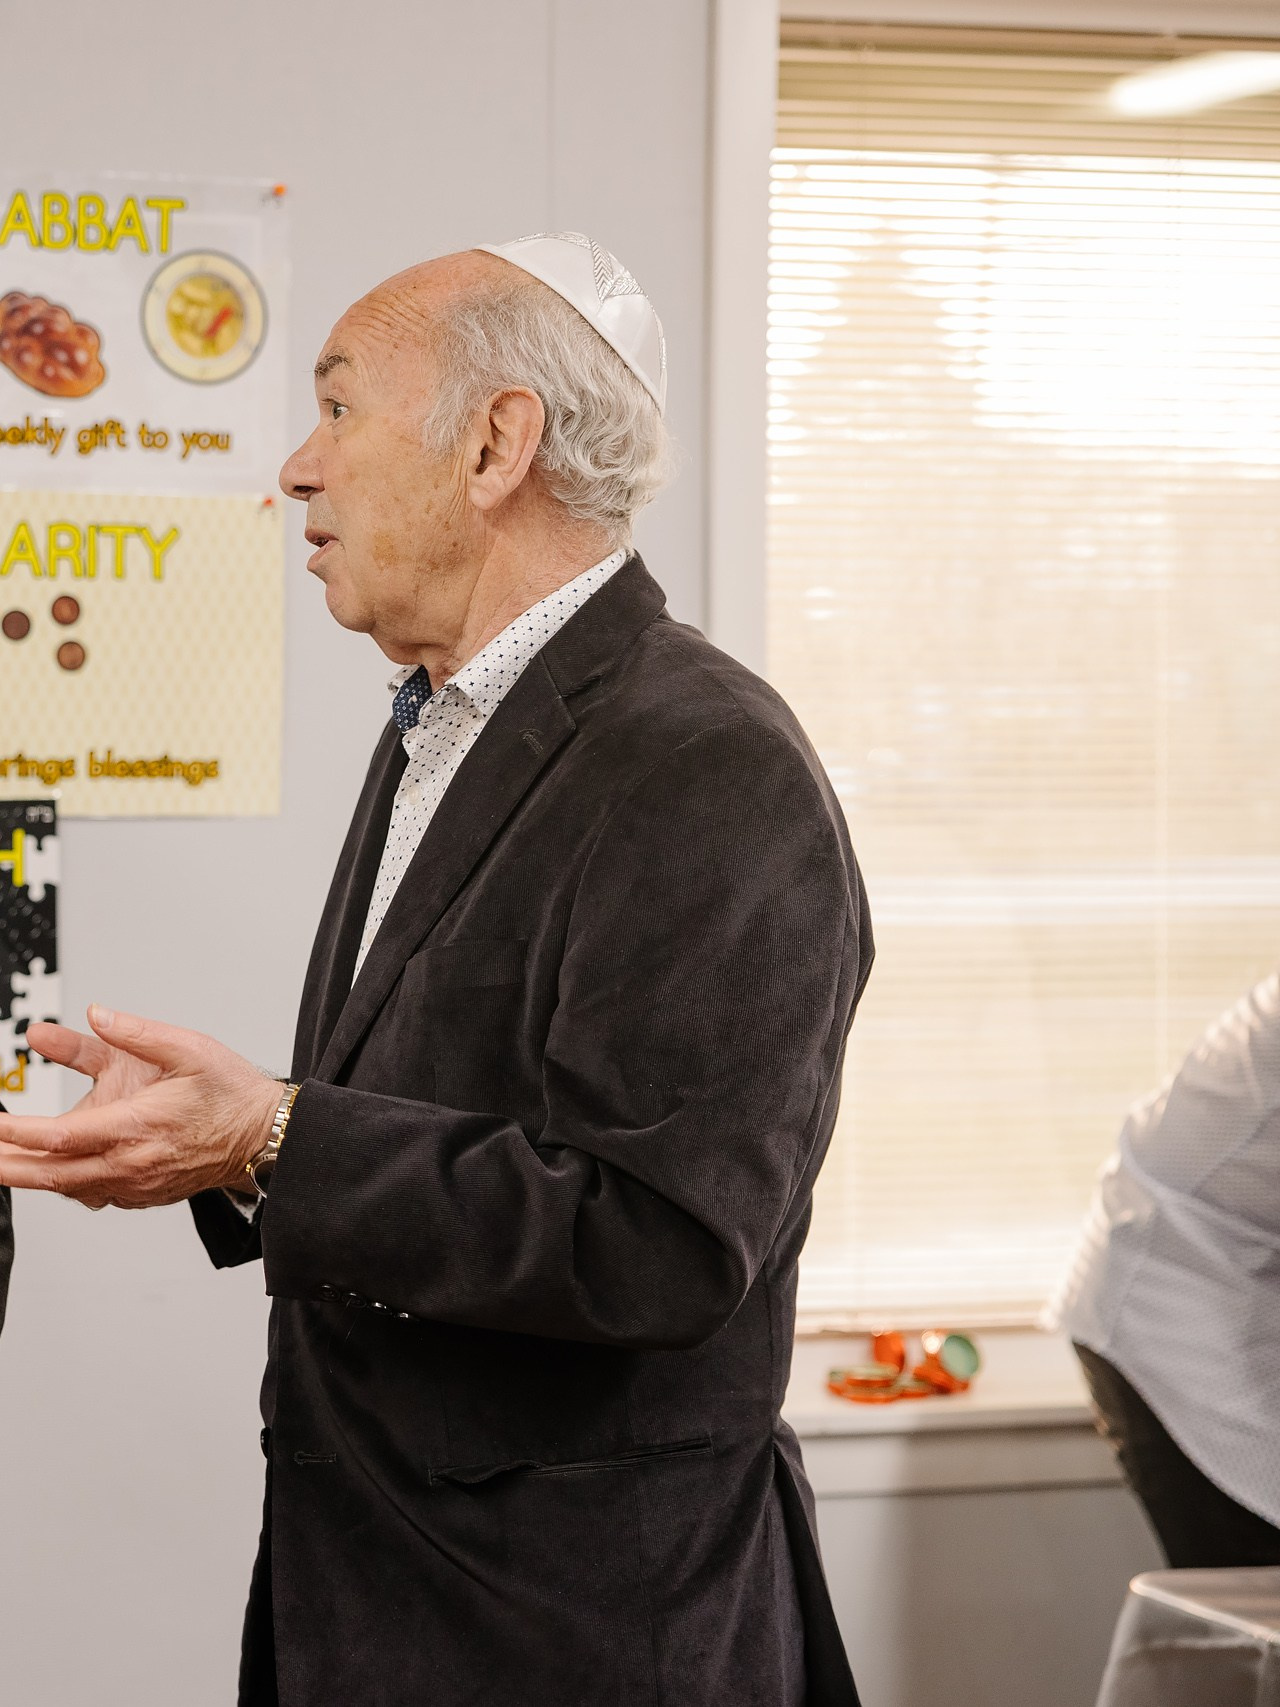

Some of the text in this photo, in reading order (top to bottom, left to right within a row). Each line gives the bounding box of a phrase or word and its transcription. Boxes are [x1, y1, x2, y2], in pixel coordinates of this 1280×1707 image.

[77, 420, 127, 456] gift
[138, 423, 169, 449] to
[181, 431, 230, 460] you
[88, 751, 219, 786] blessings
